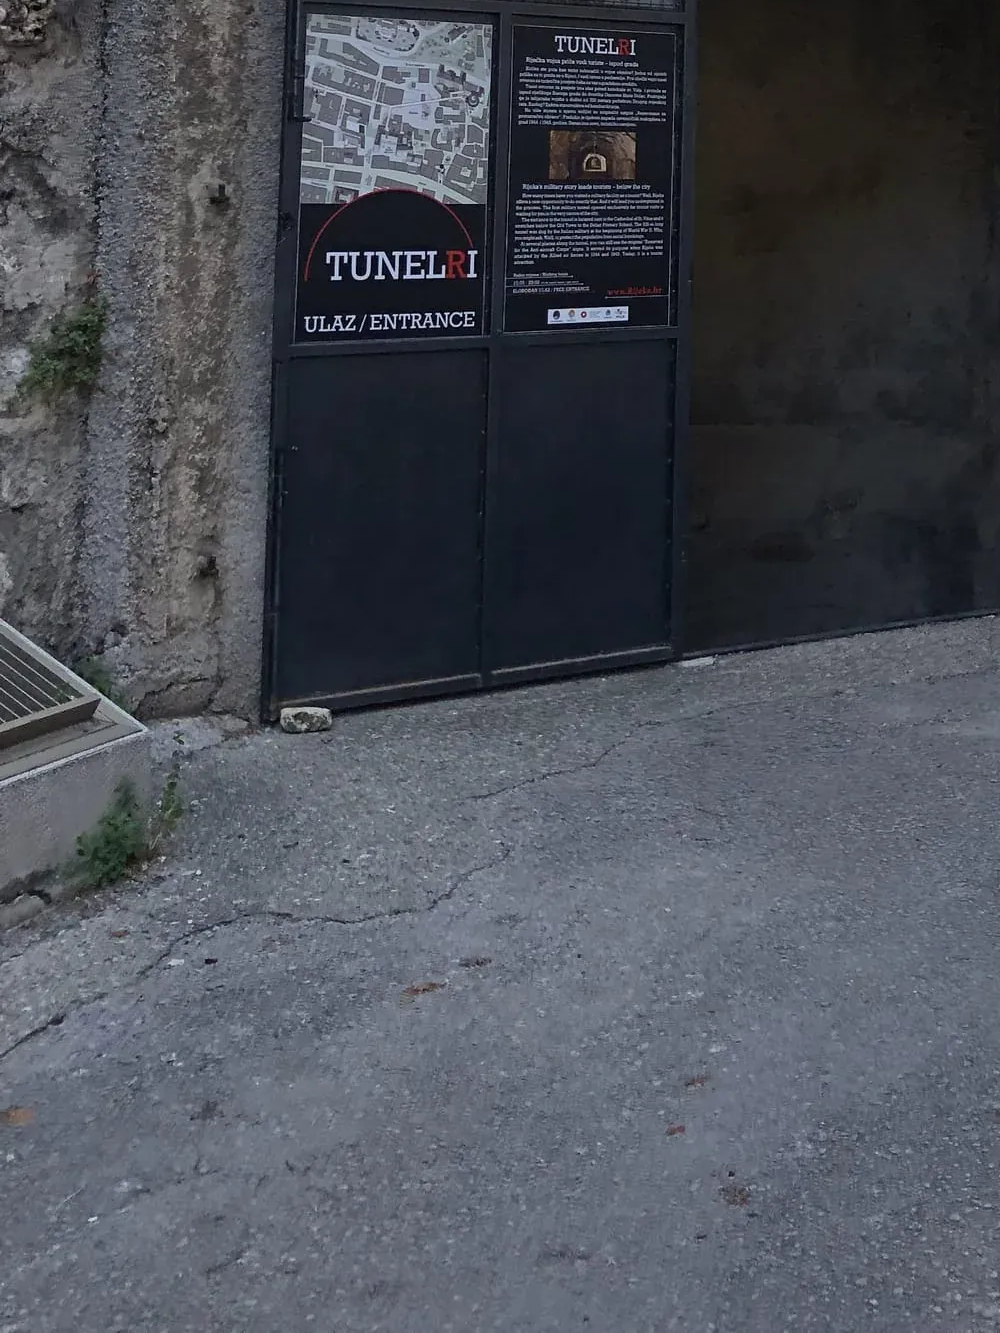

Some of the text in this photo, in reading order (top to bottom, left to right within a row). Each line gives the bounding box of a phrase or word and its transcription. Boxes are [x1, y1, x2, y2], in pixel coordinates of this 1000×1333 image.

[555, 35, 637, 56] TUNELRI
[325, 250, 478, 281] TUNELRI
[304, 315, 357, 333] ULAZ
[370, 311, 475, 331] ENTRANCE
